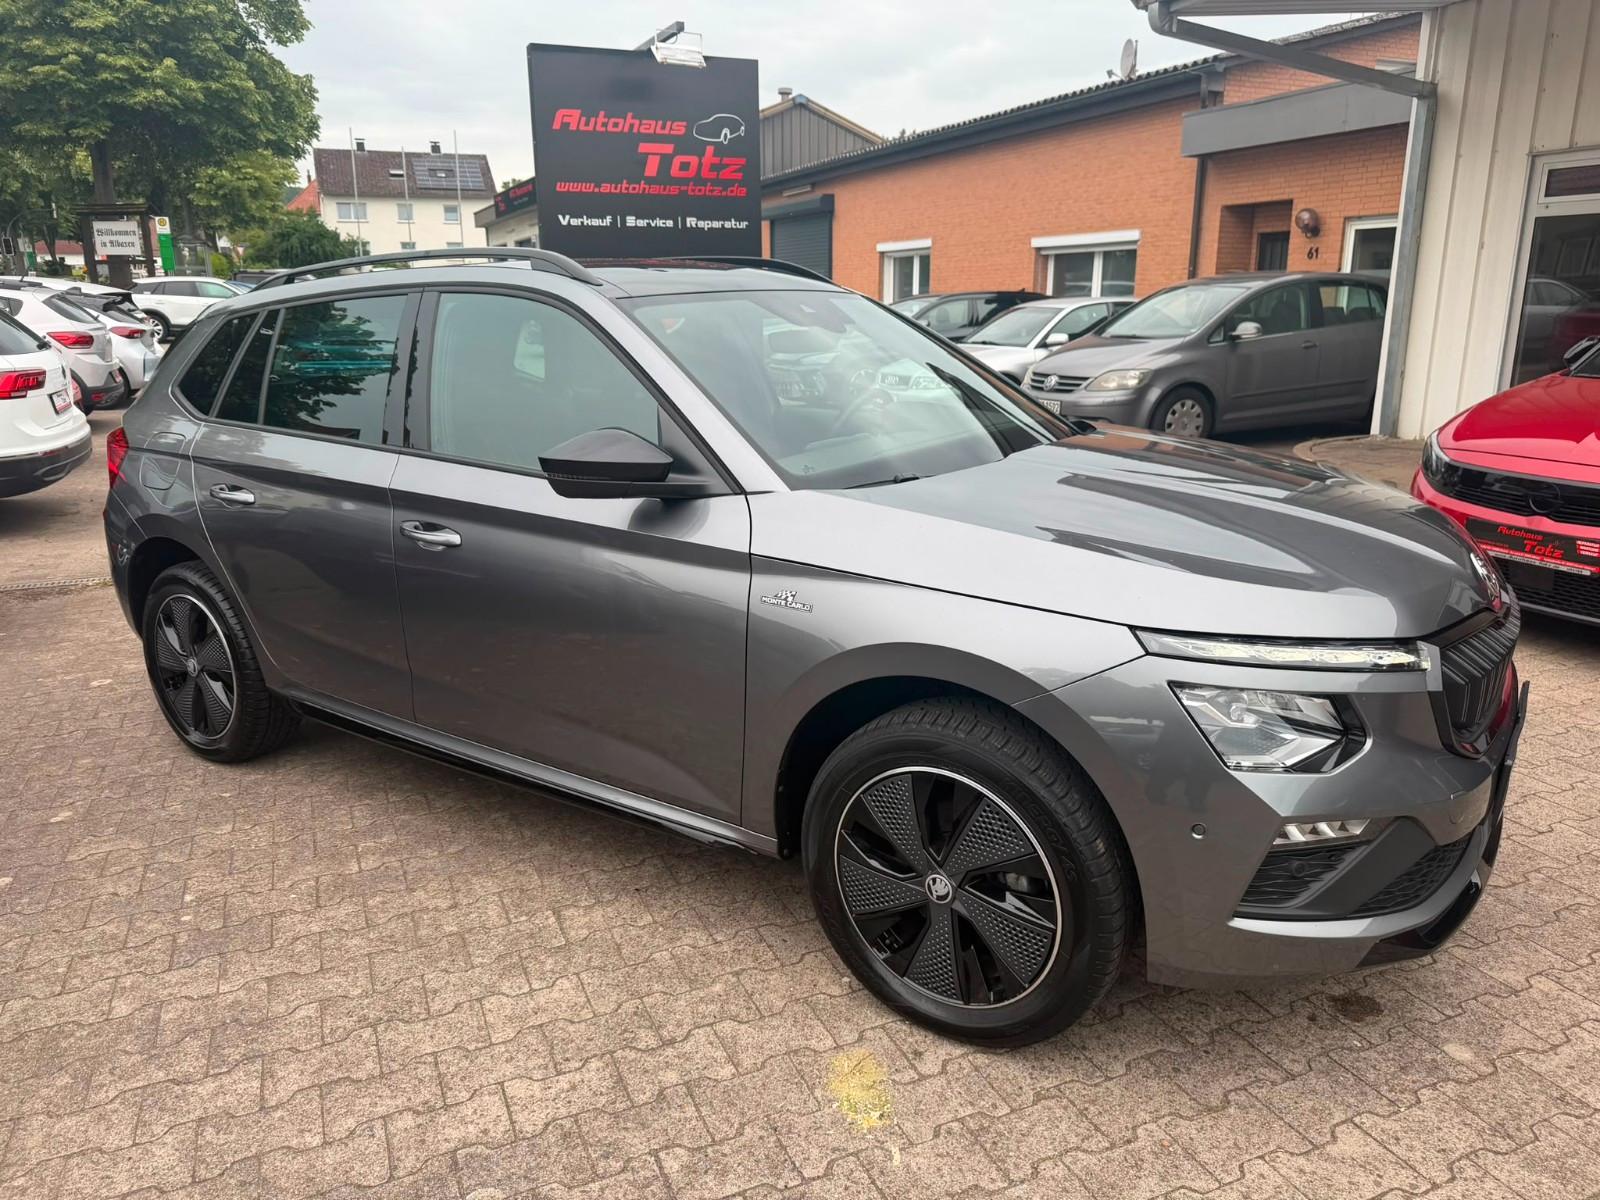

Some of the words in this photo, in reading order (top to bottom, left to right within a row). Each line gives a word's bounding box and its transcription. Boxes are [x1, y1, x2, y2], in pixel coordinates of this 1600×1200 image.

[553, 109, 687, 135] Autohaus
[638, 143, 746, 179] Totz
[556, 180, 746, 196] www.autohaus-totz.de
[557, 214, 612, 227] Verkauf
[625, 215, 674, 228] Service
[685, 216, 749, 231] Reparatur
[96, 228, 136, 236] Willkommen
[1307, 246, 1319, 260] 61
[1524, 540, 1563, 558] Totz
[762, 596, 785, 605] MONTE
[787, 601, 810, 610] CARLO
